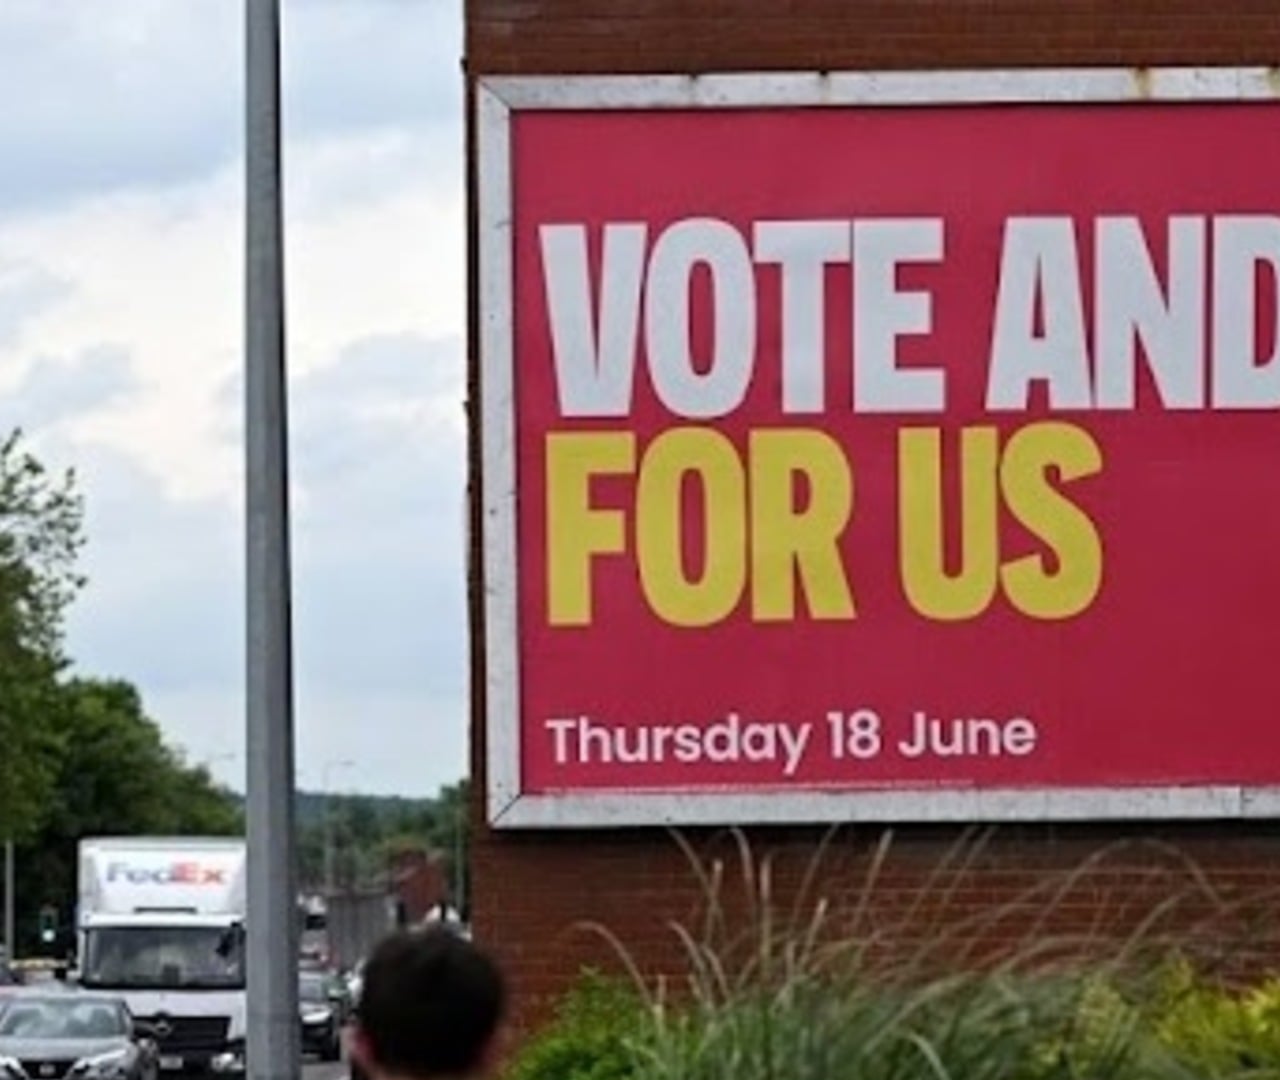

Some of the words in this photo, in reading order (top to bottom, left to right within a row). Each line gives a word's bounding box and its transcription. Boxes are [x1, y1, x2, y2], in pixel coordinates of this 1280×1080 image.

[538, 216, 947, 420] VOTE
[545, 426, 858, 628] FOR
[898, 421, 1104, 622] US
[545, 714, 812, 776] Thursday
[826, 710, 881, 758] 18
[898, 711, 1038, 758] June
[107, 862, 226, 885] FedEx
